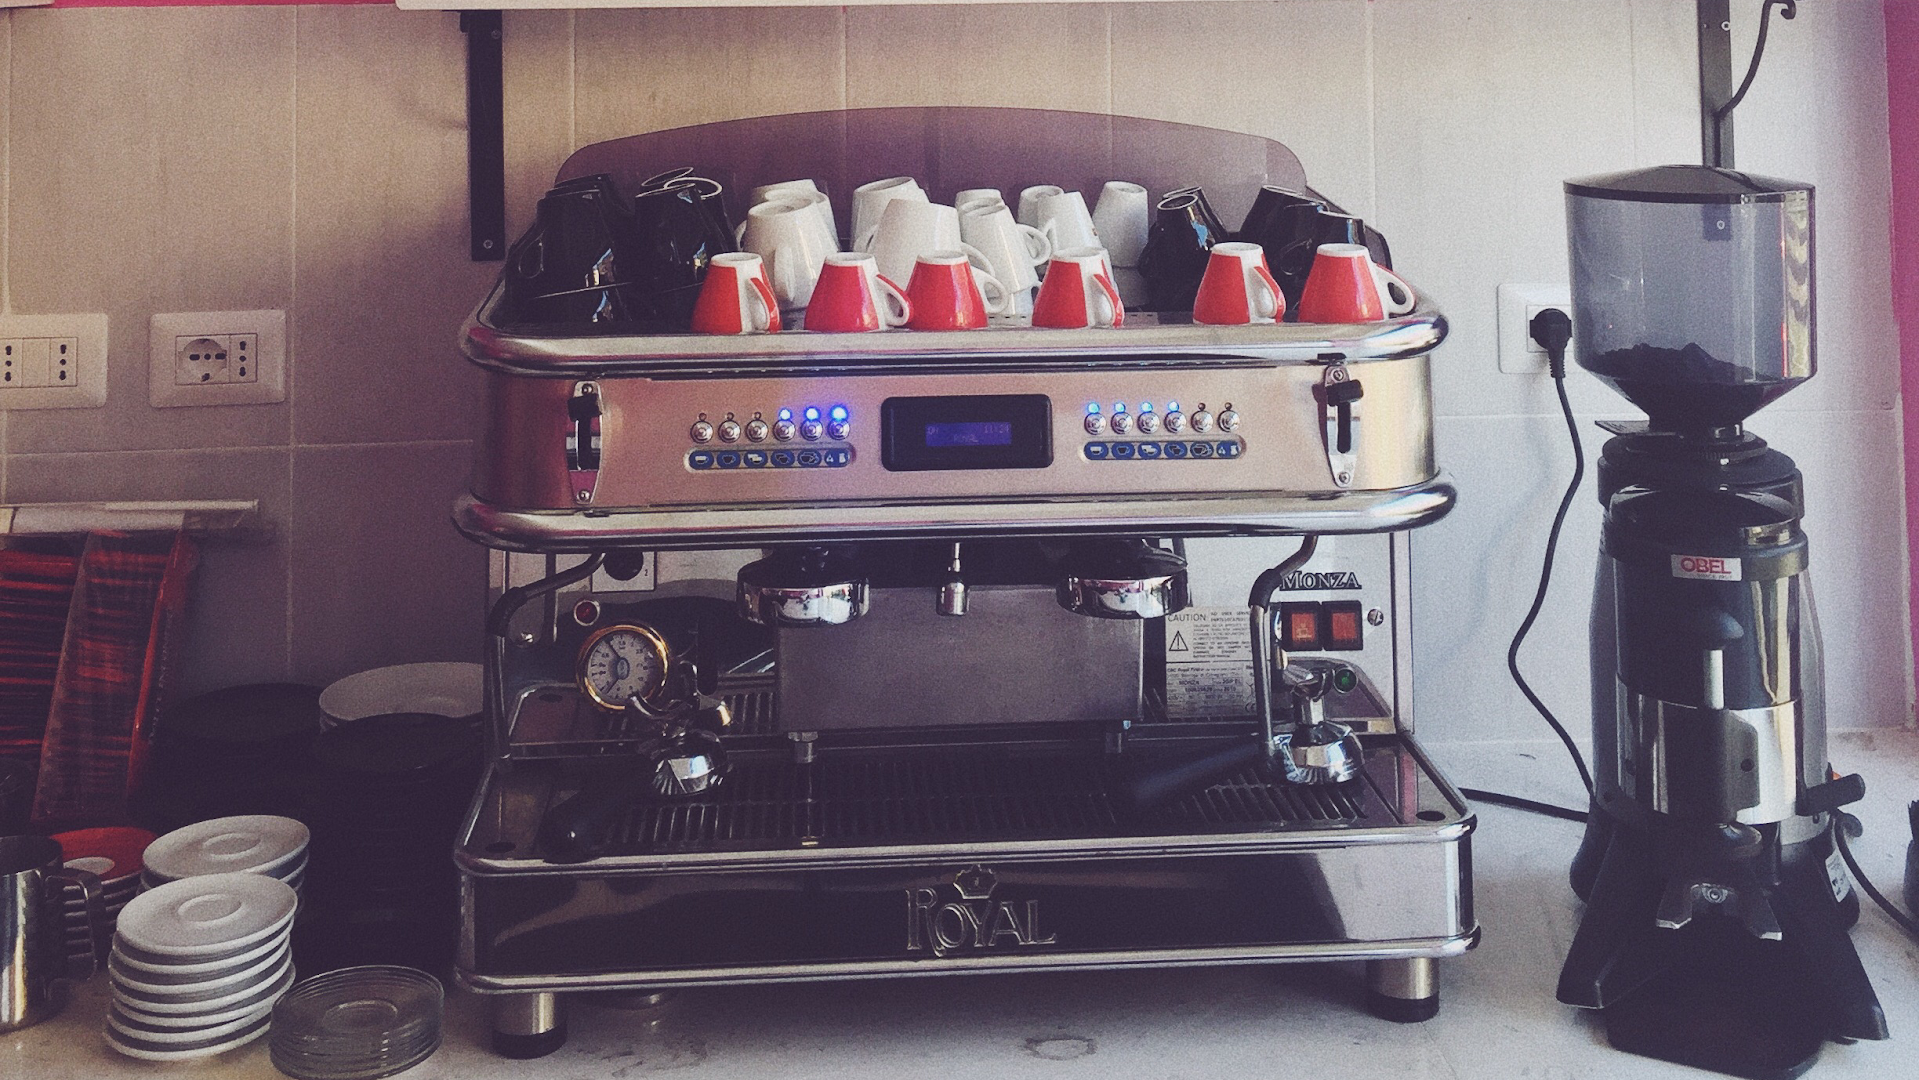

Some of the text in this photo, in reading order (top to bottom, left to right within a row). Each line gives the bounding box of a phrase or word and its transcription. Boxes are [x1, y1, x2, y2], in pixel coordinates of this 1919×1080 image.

[644, 569, 648, 577] 2
[1680, 557, 1732, 574] OBEL
[1280, 570, 1361, 590] MONZA
[1167, 613, 1207, 622] CAUTION
[905, 887, 1056, 957] ROYAL
